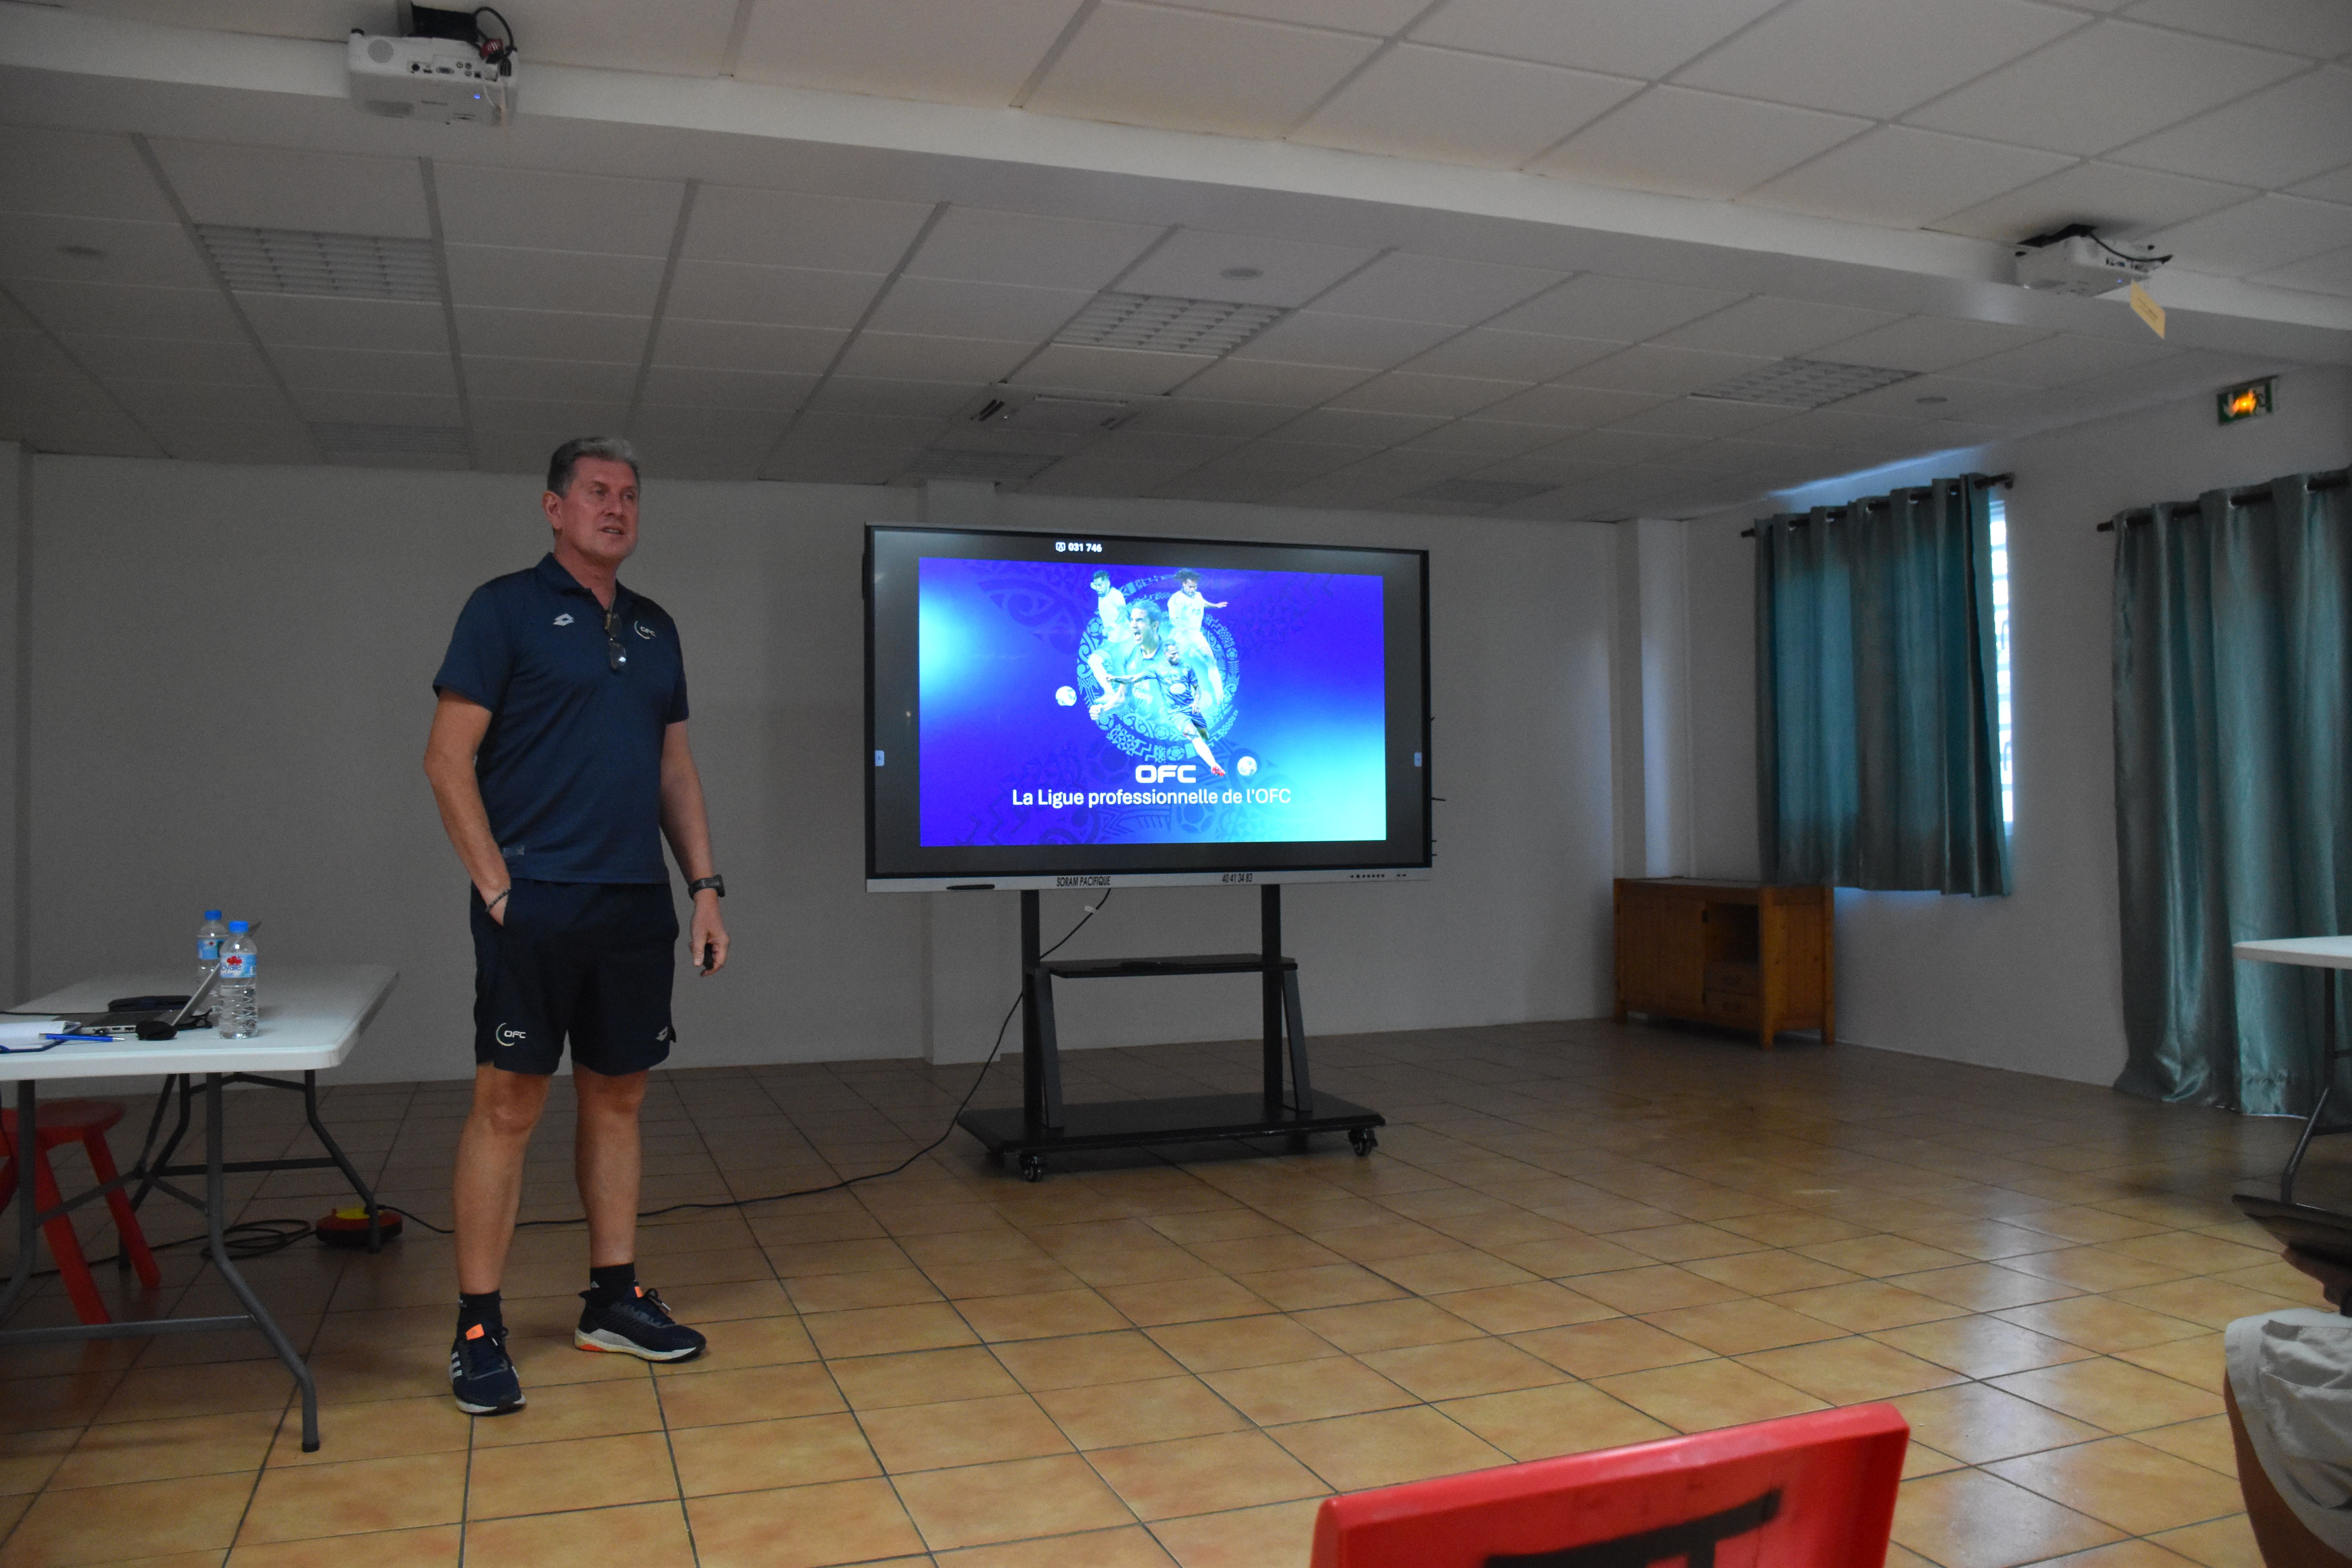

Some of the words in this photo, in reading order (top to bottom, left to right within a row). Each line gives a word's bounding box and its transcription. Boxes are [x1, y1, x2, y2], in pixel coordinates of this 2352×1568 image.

[1068, 542, 1084, 552] 031
[1085, 543, 1103, 553] 746
[1135, 765, 1196, 783] OFC
[1013, 789, 1033, 805] La
[1038, 789, 1084, 809] Ligue
[1088, 788, 1218, 808] professionnelle
[1222, 789, 1243, 804] de
[1247, 788, 1291, 804] l'OFC
[1056, 877, 1078, 887] SORAM
[1080, 876, 1111, 886] PACIFIQUE
[504, 1030, 526, 1038] OFC
